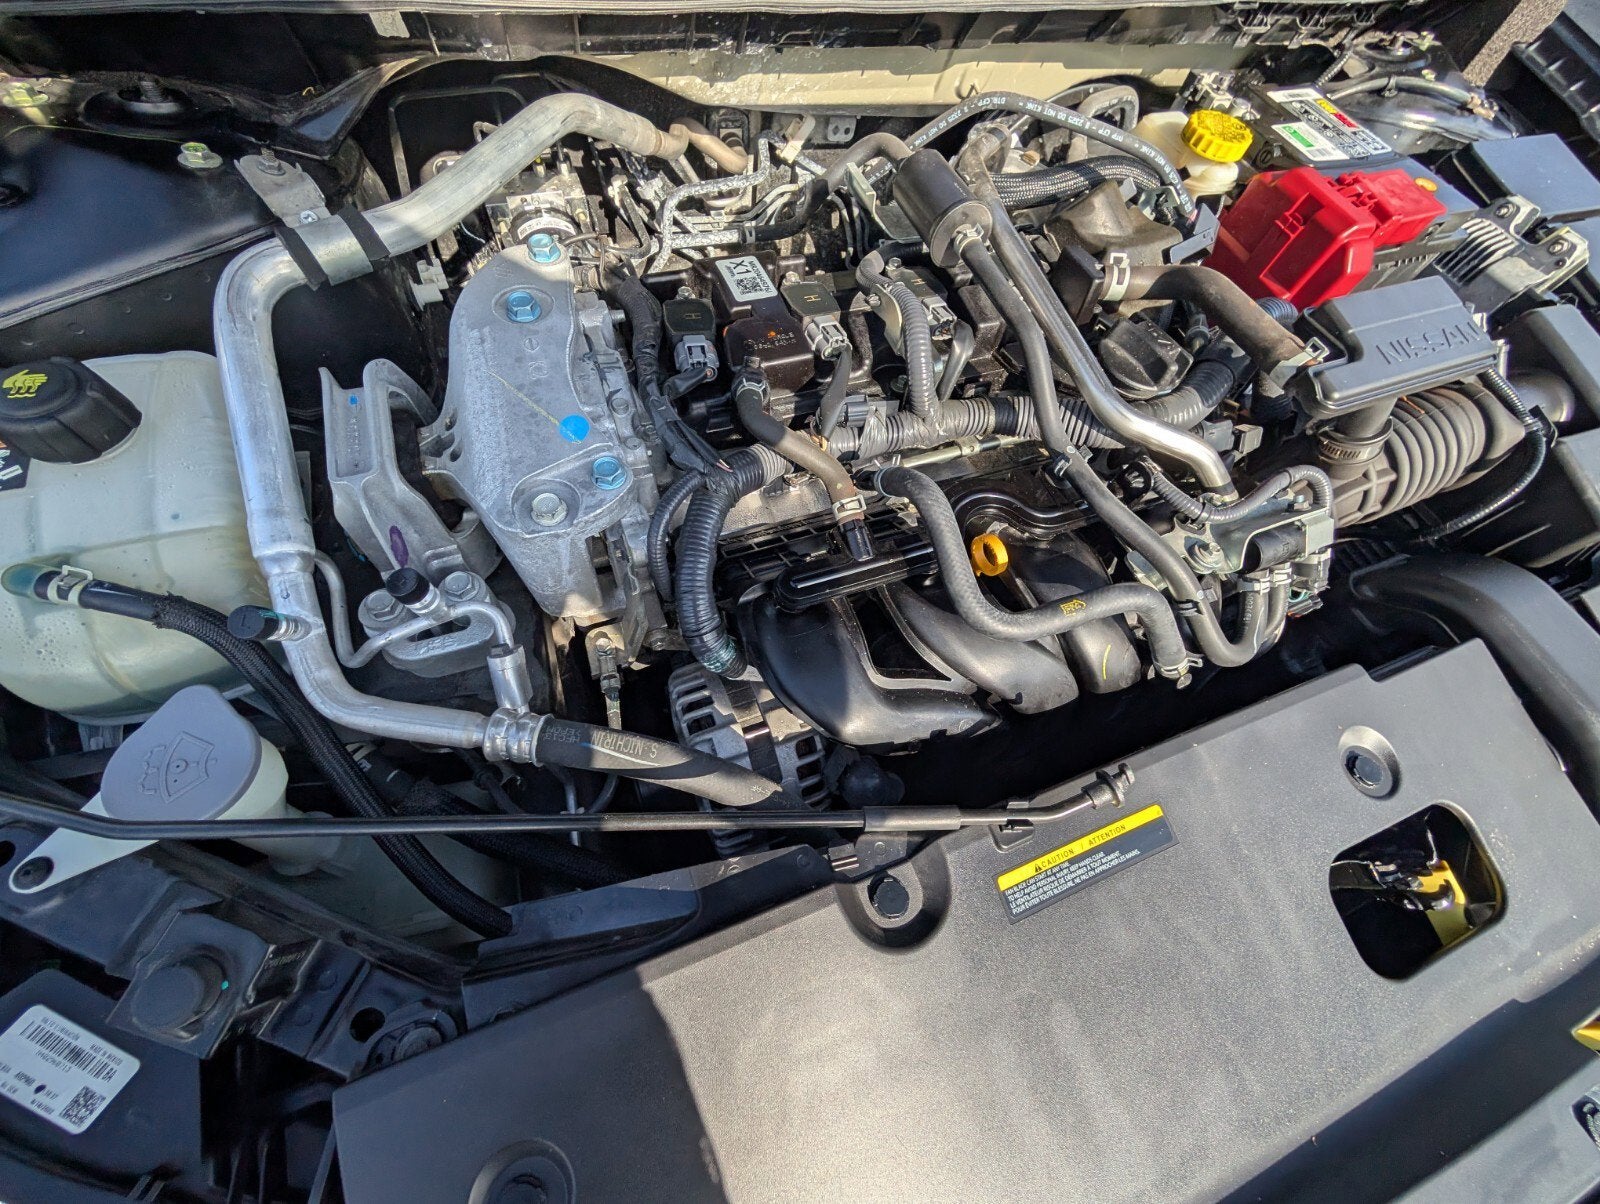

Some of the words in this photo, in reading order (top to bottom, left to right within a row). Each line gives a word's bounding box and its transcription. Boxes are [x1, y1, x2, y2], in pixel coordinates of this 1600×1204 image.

[730, 260, 751, 276] X1
[1375, 320, 1480, 366] NISSAN
[590, 729, 643, 755] NICHIRIN
[1040, 847, 1074, 868] CAUTION
[1087, 823, 1126, 846] ATTENTION
